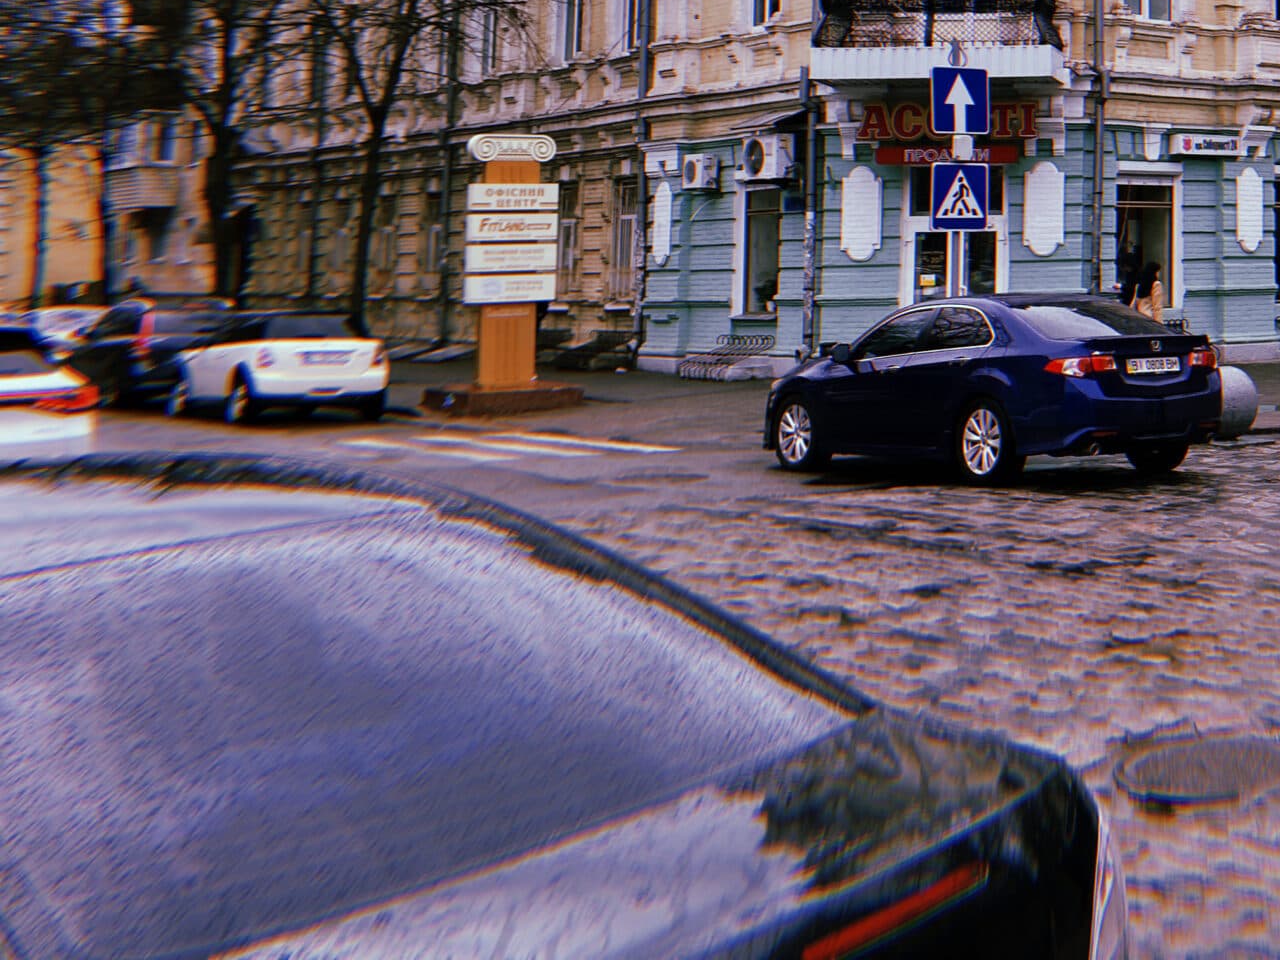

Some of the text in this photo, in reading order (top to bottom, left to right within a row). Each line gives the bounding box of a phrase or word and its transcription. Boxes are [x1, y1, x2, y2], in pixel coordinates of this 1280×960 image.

[856, 102, 1039, 139] АСТІ
[904, 148, 990, 162] ПРОДТИ
[496, 198, 538, 208] ЦЕНТР
